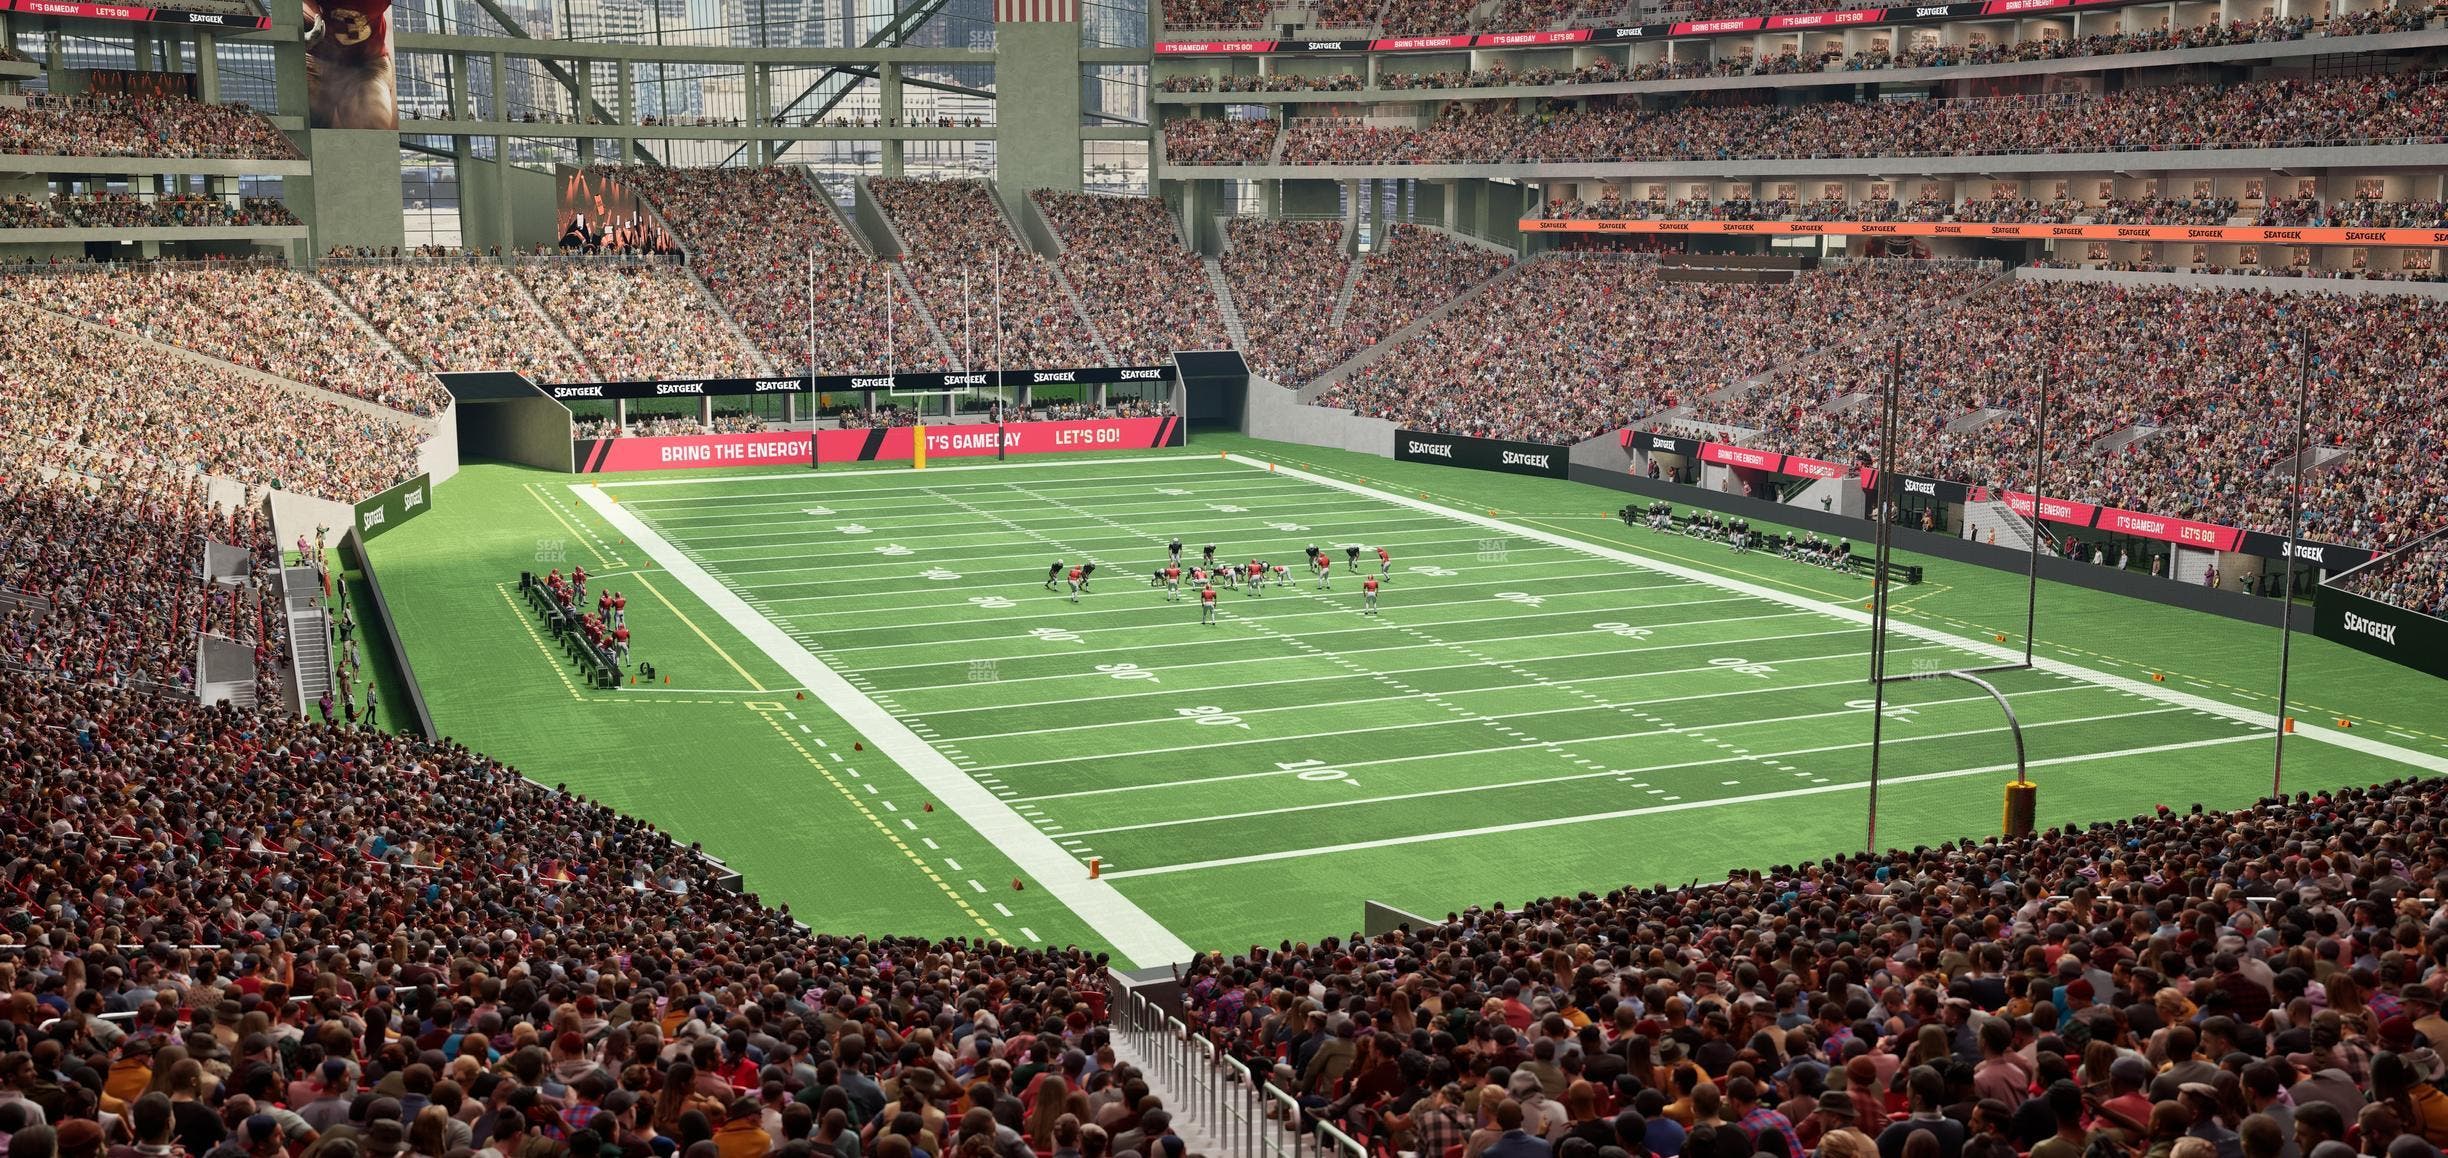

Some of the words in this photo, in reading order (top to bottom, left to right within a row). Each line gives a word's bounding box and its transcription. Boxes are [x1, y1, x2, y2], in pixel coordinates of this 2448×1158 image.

[30, 3, 42, 11] IT'S
[44, 4, 80, 14] GAMEDAY
[96, 8, 114, 16] LET'S
[116, 8, 130, 17] GO!
[1916, 6, 1948, 18] SEATGEEK
[189, 13, 224, 24] SEATGEEK
[1782, 18, 1794, 26] IT'S
[1794, 16, 1822, 24] GAMEDAY
[1835, 14, 1851, 22] LET'S
[1616, 27, 1642, 37] SEATGEEK
[1308, 42, 1341, 50] SEATGEEK
[2118, 228, 2150, 237] SEATGEEK
[2188, 229, 2223, 238] SEATGEEK
[2264, 231, 2302, 239] SEATGEEK
[2346, 232, 2385, 241] SEATGEEK
[944, 374, 987, 386] SEATGEEK
[1033, 371, 1075, 383] SEATGEEK
[1120, 369, 1161, 380] SEATGEEK
[656, 382, 704, 395] SEATGEEK
[756, 380, 801, 392] SEATGEEK
[851, 376, 895, 389] SEATGEEK
[554, 385, 603, 398] SEATGEEK
[1056, 428, 1092, 444] LET'S
[1096, 427, 1120, 443] GO!
[1408, 440, 1452, 458] SEATGEEK
[1652, 437, 1675, 451] SEATGEEK
[662, 444, 711, 462] BRING
[715, 443, 744, 460] THE
[748, 441, 812, 459] ENERGY!
[1718, 449, 1732, 460] BRING
[1734, 452, 1742, 461] THE
[1743, 453, 1764, 465] ENERGY!
[1502, 451, 1549, 469] SEATGEEK
[1904, 479, 1936, 496] SEATGEEK
[404, 485, 423, 512] SEATGEEK
[2032, 502, 2043, 513] TE
[2044, 504, 2071, 518] ENERGY!
[364, 504, 384, 531] SEATGEEK
[2117, 516, 2130, 528] IT'S
[2131, 520, 2165, 534] GAMEDAY
[2180, 526, 2200, 540] LET'S
[2202, 532, 2215, 543] GO!
[2344, 611, 2396, 646] SEATGEEK
[1095, 663, 1154, 680] 30
[1174, 706, 1242, 725] 20
[1274, 759, 1348, 780] 10
